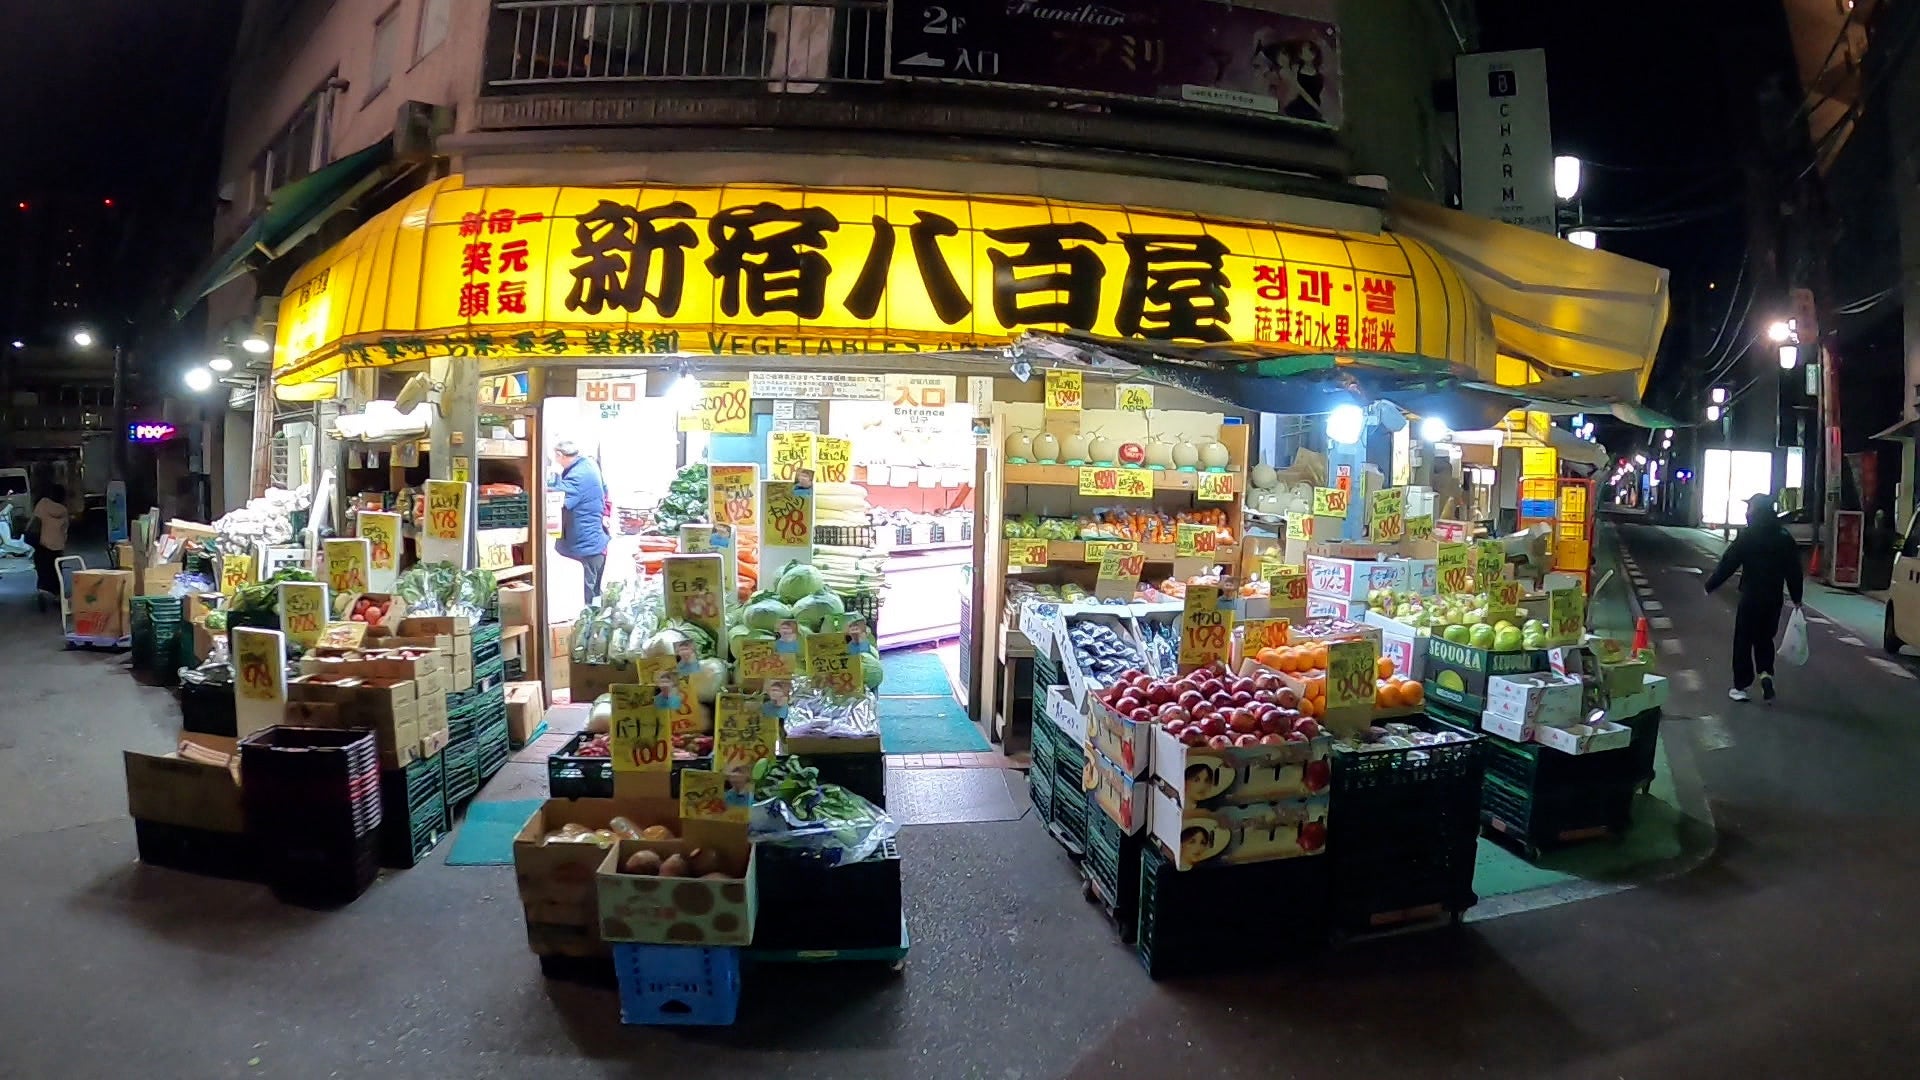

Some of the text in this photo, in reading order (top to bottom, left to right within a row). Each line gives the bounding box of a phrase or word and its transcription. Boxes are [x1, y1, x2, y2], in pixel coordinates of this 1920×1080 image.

[923, 6, 967, 35] 2F
[953, 46, 999, 76] 入口
[1500, 103, 1515, 201] CHARM
[566, 200, 1233, 343] 新宿八百屋
[586, 382, 636, 401] 出口
[893, 386, 945, 407] 入口
[1127, 390, 1144, 404] 24h
[714, 388, 747, 424] 228
[894, 408, 945, 416] Entrance
[910, 416, 929, 424] 입구
[822, 462, 846, 483] 158
[775, 508, 808, 540] 98
[1189, 625, 1225, 649] 198
[632, 739, 668, 768] 100
